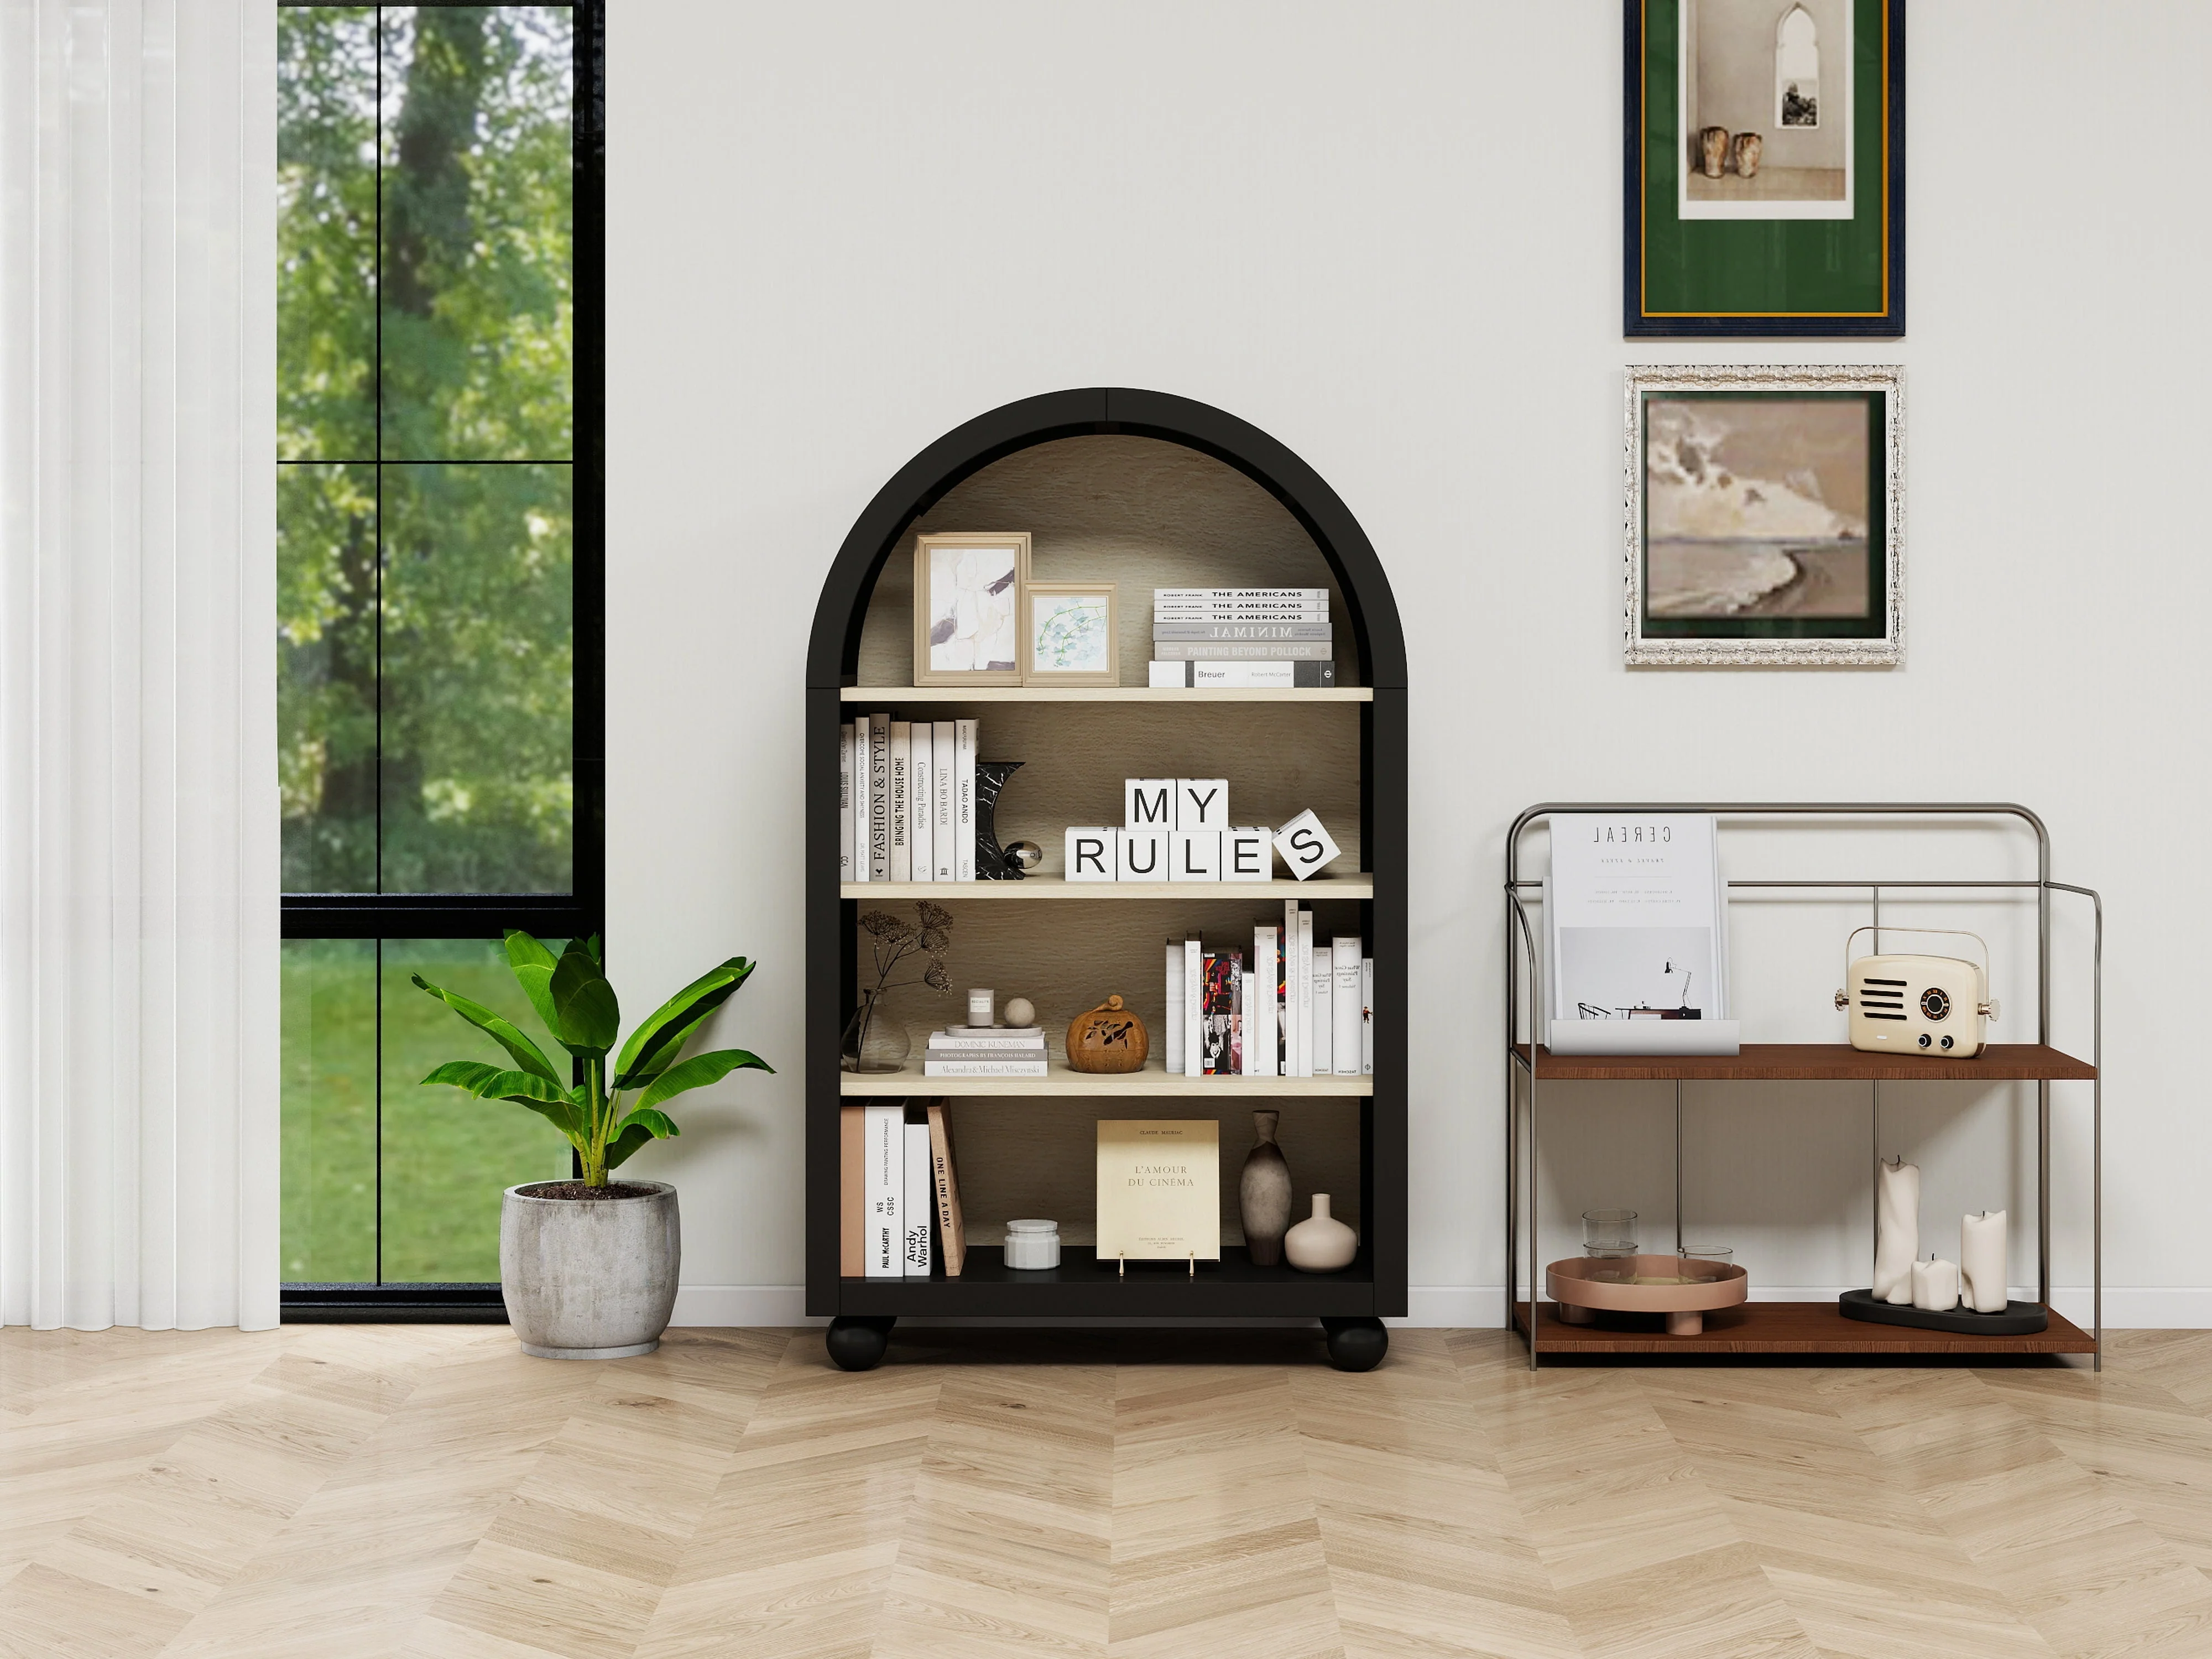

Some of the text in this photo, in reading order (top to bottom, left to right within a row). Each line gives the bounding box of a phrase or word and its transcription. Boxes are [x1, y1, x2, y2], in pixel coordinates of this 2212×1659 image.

[1188, 647, 1311, 656] PAINTING BEYOND POLLOCK
[874, 727, 885, 860] FASHION & STYLE
[895, 758, 904, 846] BRINGING THE HOUSE HOME
[940, 789, 947, 800] BO
[1134, 788, 1218, 823] MY
[1076, 828, 1324, 874] RULES
[877, 1202, 883, 1212] WS
[906, 1230, 919, 1262] Andy
[917, 1226, 927, 1267] Warhol
